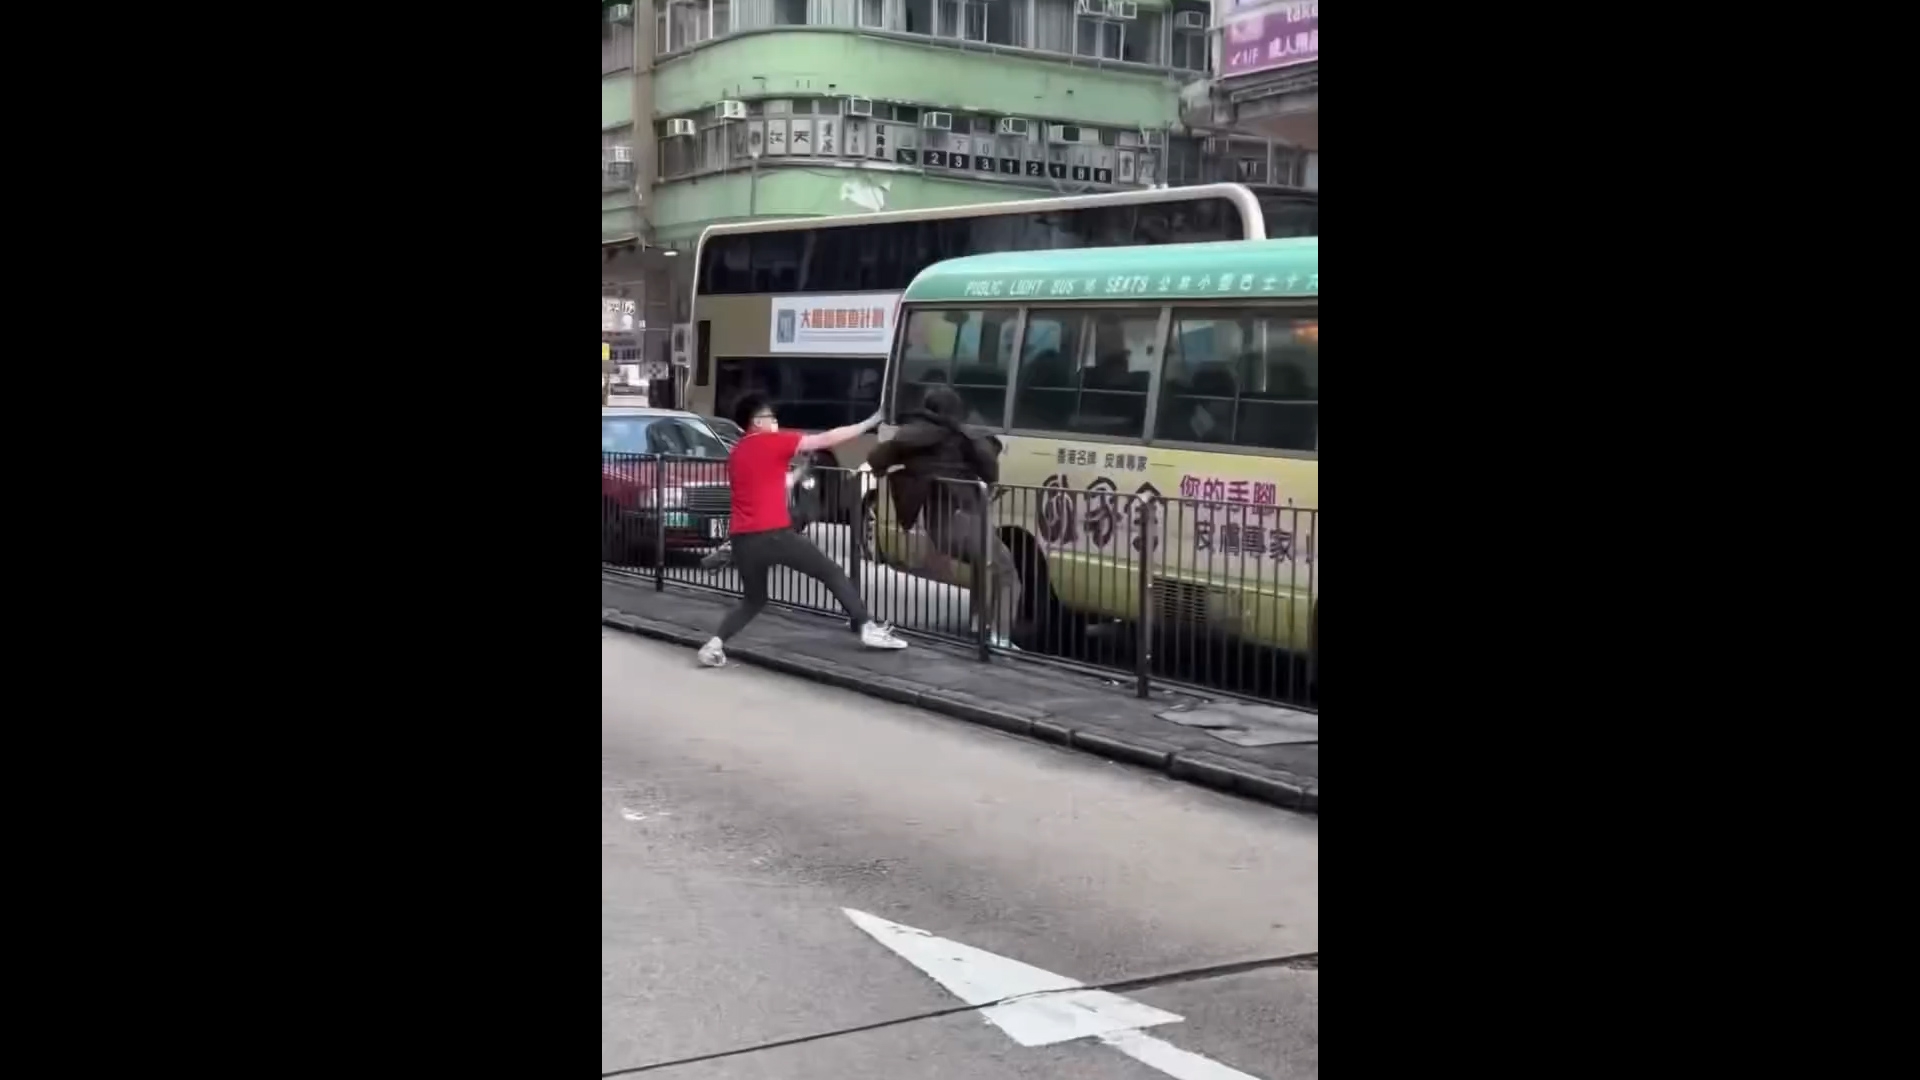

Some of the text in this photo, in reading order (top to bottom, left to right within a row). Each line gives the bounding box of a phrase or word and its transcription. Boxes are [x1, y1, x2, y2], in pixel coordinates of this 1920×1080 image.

[1009, 278, 1043, 296] LIGHT
[1051, 279, 1077, 296] BUS
[1106, 275, 1150, 294] SEATS
